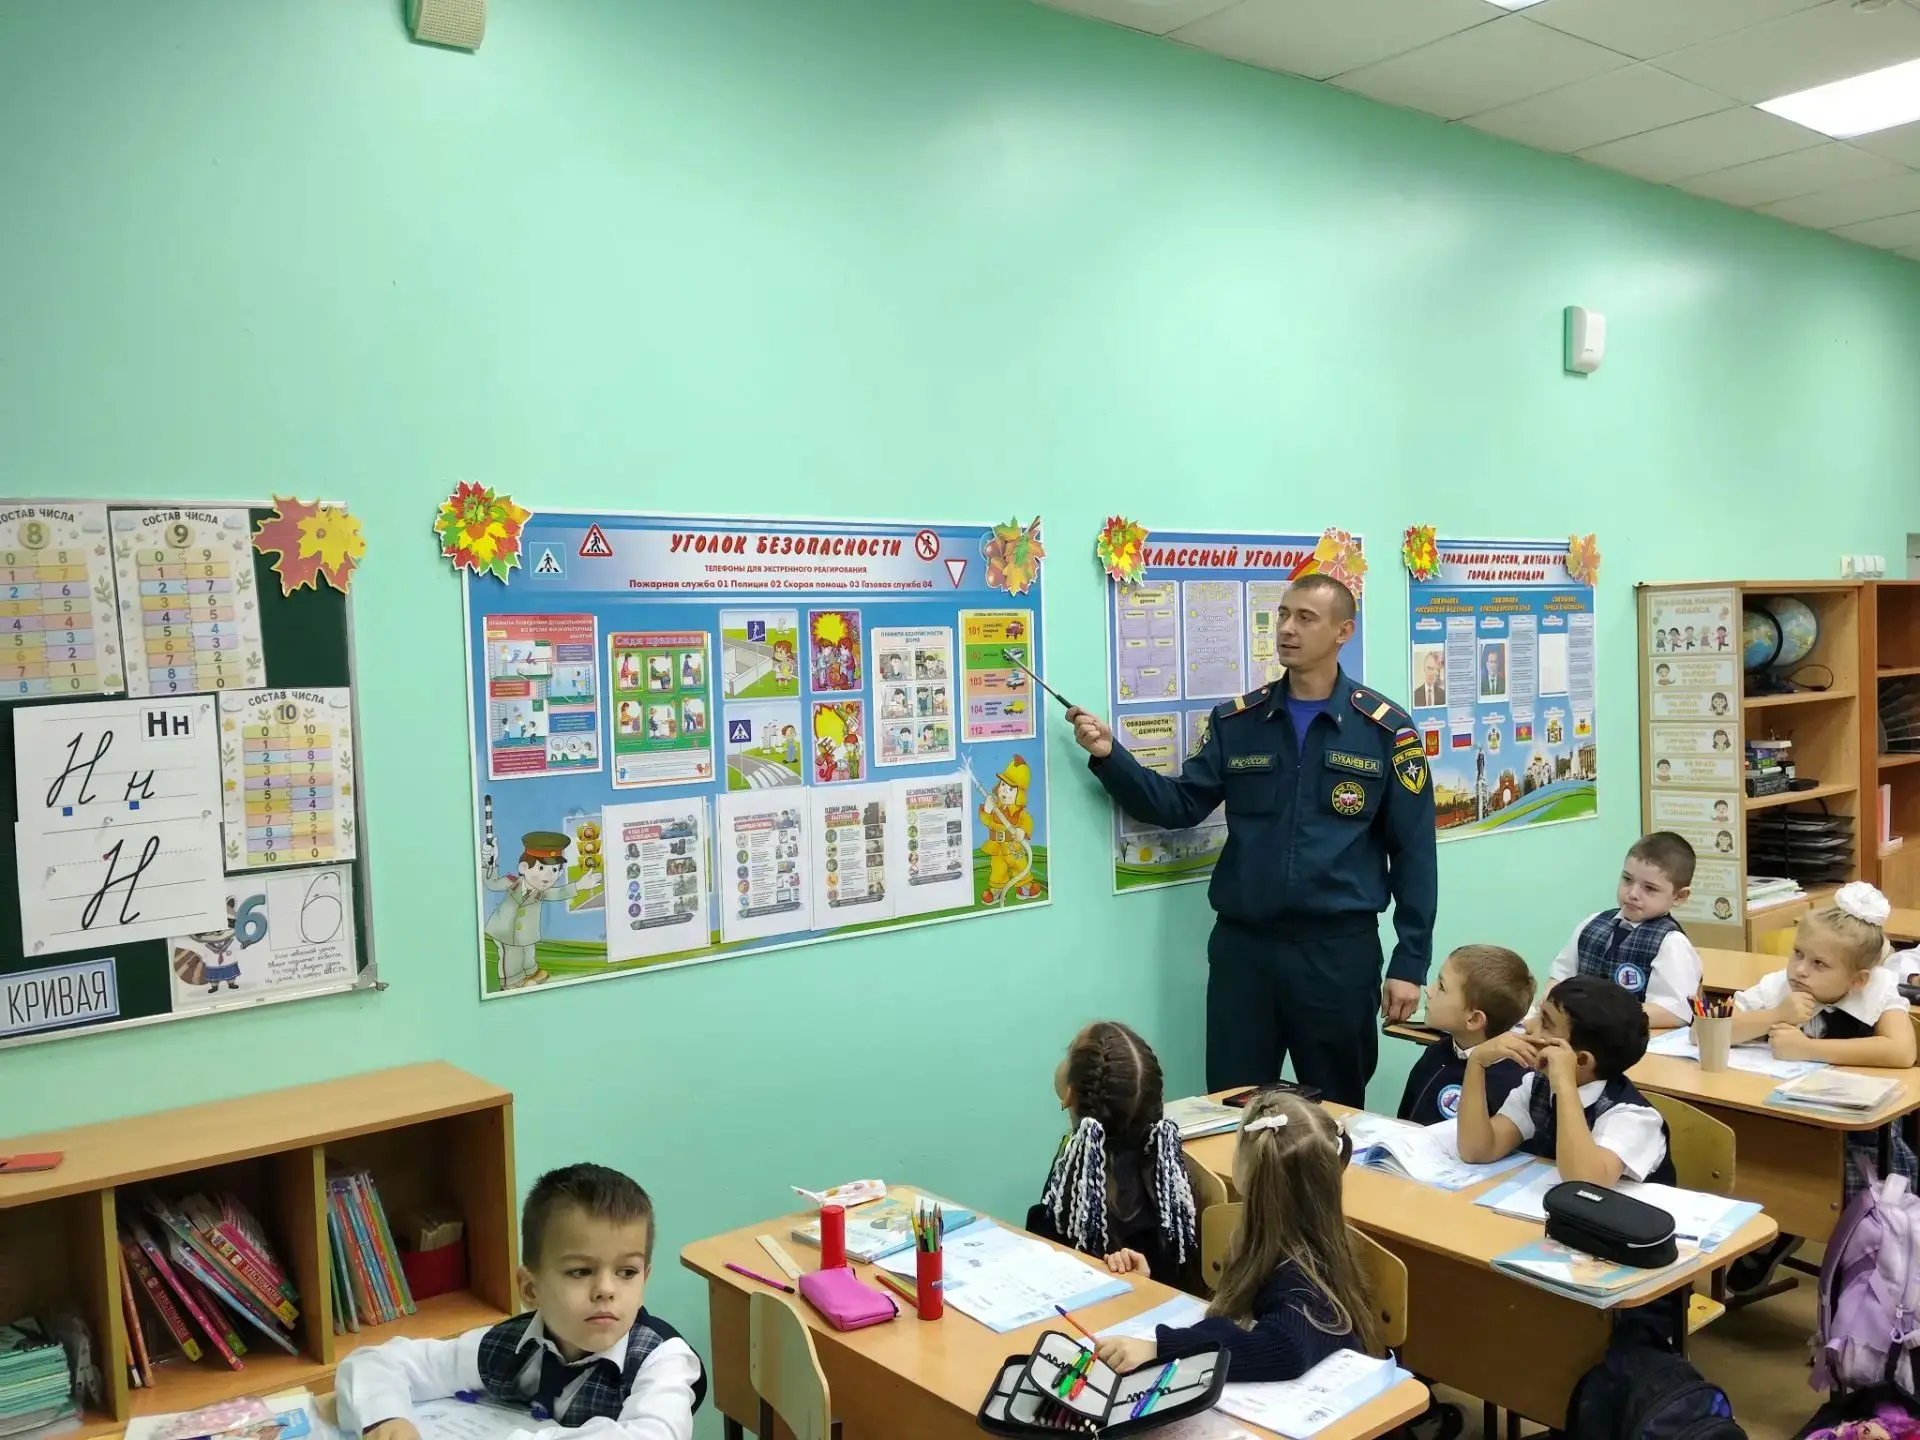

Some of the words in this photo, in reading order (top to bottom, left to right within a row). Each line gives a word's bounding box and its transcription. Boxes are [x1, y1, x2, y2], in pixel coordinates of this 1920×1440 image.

[39, 508, 75, 524] ЧИСЛА
[142, 511, 181, 527] СОСТАВ
[185, 511, 218, 525] ЧИСЛА
[27, 523, 42, 545] 8
[174, 524, 188, 545] 9
[670, 533, 747, 555] УГОЛОК
[756, 535, 902, 556] БЕЗОПАСНОСТИ
[6, 553, 15, 566] 0
[59, 551, 68, 564] 8
[155, 551, 164, 563] 0
[203, 550, 211, 562] 9
[1143, 545, 1237, 567] КЛАССНЫЙ
[1244, 550, 1303, 568] УГОЛОК
[1441, 553, 1489, 565] ГРАЖДАНИН
[1491, 554, 1521, 566] РОССИИ,
[1522, 555, 1550, 565] ЖИТЕЛЬ
[9, 570, 15, 582] 1
[60, 568, 69, 581] 7
[158, 566, 164, 578] 1
[204, 564, 214, 577] 8
[705, 564, 746, 573] ТЕЛЕФОНЫ
[747, 565, 762, 574] ДЛЯ
[763, 565, 812, 574] ЭКСТРЕННОГО
[813, 566, 867, 574] РЕАГИРОВАНИЯ
[1467, 570, 1495, 581] ГОРОДА
[1498, 570, 1545, 581] КРАСНОДАРА
[10, 586, 19, 599] 2
[62, 583, 71, 597] 6
[158, 581, 168, 594] 2
[206, 580, 215, 592] 7
[629, 579, 679, 590] Пожарная
[681, 580, 715, 591] служба
[717, 580, 728, 588] 01
[731, 580, 769, 589] Полиция
[770, 580, 781, 588] 02
[784, 580, 814, 590] Скорая
[815, 581, 848, 589] помощь
[849, 580, 860, 588] 03
[861, 580, 892, 589] Газовая
[893, 581, 921, 590] служба
[922, 580, 933, 589] 04
[11, 602, 20, 615] 3
[64, 600, 73, 612] 5
[160, 596, 169, 609] 3
[207, 595, 217, 607] 6
[13, 618, 22, 631] 4
[64, 616, 74, 628] 4
[161, 611, 171, 624] 4
[209, 609, 218, 621] 5
[163, 625, 172, 638] 5
[210, 622, 220, 635] 4
[968, 626, 980, 635] 101
[15, 634, 24, 647] 5
[67, 631, 75, 644] 3
[164, 640, 173, 652] 6
[211, 637, 220, 649] 3
[16, 649, 25, 662] 6
[68, 647, 77, 659] 2
[165, 654, 174, 666] 7
[213, 651, 223, 663] 2
[17, 665, 26, 677] 7
[70, 662, 76, 674] 1
[167, 668, 177, 680] 8
[216, 664, 222, 676] 1
[19, 680, 29, 694] 8
[71, 678, 80, 690] 0
[168, 681, 178, 693] 9
[216, 678, 225, 689] 0
[970, 677, 982, 686] 103
[248, 691, 287, 707] СОСТАВ
[291, 691, 325, 705] ЧИСЛА
[276, 703, 297, 721] 10
[970, 705, 983, 714] 104
[261, 726, 269, 738] 0
[303, 724, 316, 735] 10
[971, 726, 983, 735] 112
[1126, 719, 1169, 728] ОБЯЗАННОСТИ
[1138, 727, 1173, 736] ДЕЖУРНЫХ
[263, 739, 269, 750] 1
[306, 737, 315, 748] 9
[262, 752, 270, 763] 2
[306, 750, 315, 761] 8
[46, 730, 113, 808] Н
[262, 764, 271, 776] 3
[308, 762, 316, 773] 7
[263, 777, 272, 788] 4
[308, 775, 316, 785] 6
[263, 789, 272, 800] 5
[308, 787, 317, 798] 5
[264, 802, 273, 813] 6
[308, 799, 318, 810] 4
[825, 805, 841, 814] ОДИН
[265, 814, 273, 825] 7
[309, 811, 318, 822] 3
[265, 827, 274, 838] 8
[310, 823, 319, 834] 2
[265, 839, 274, 850] 9
[311, 836, 317, 846] 1
[263, 852, 277, 862] 10
[311, 848, 319, 858] 0
[81, 835, 160, 931] Н
[235, 893, 268, 949] 6
[7, 970, 108, 1026] КРИВАЯ
